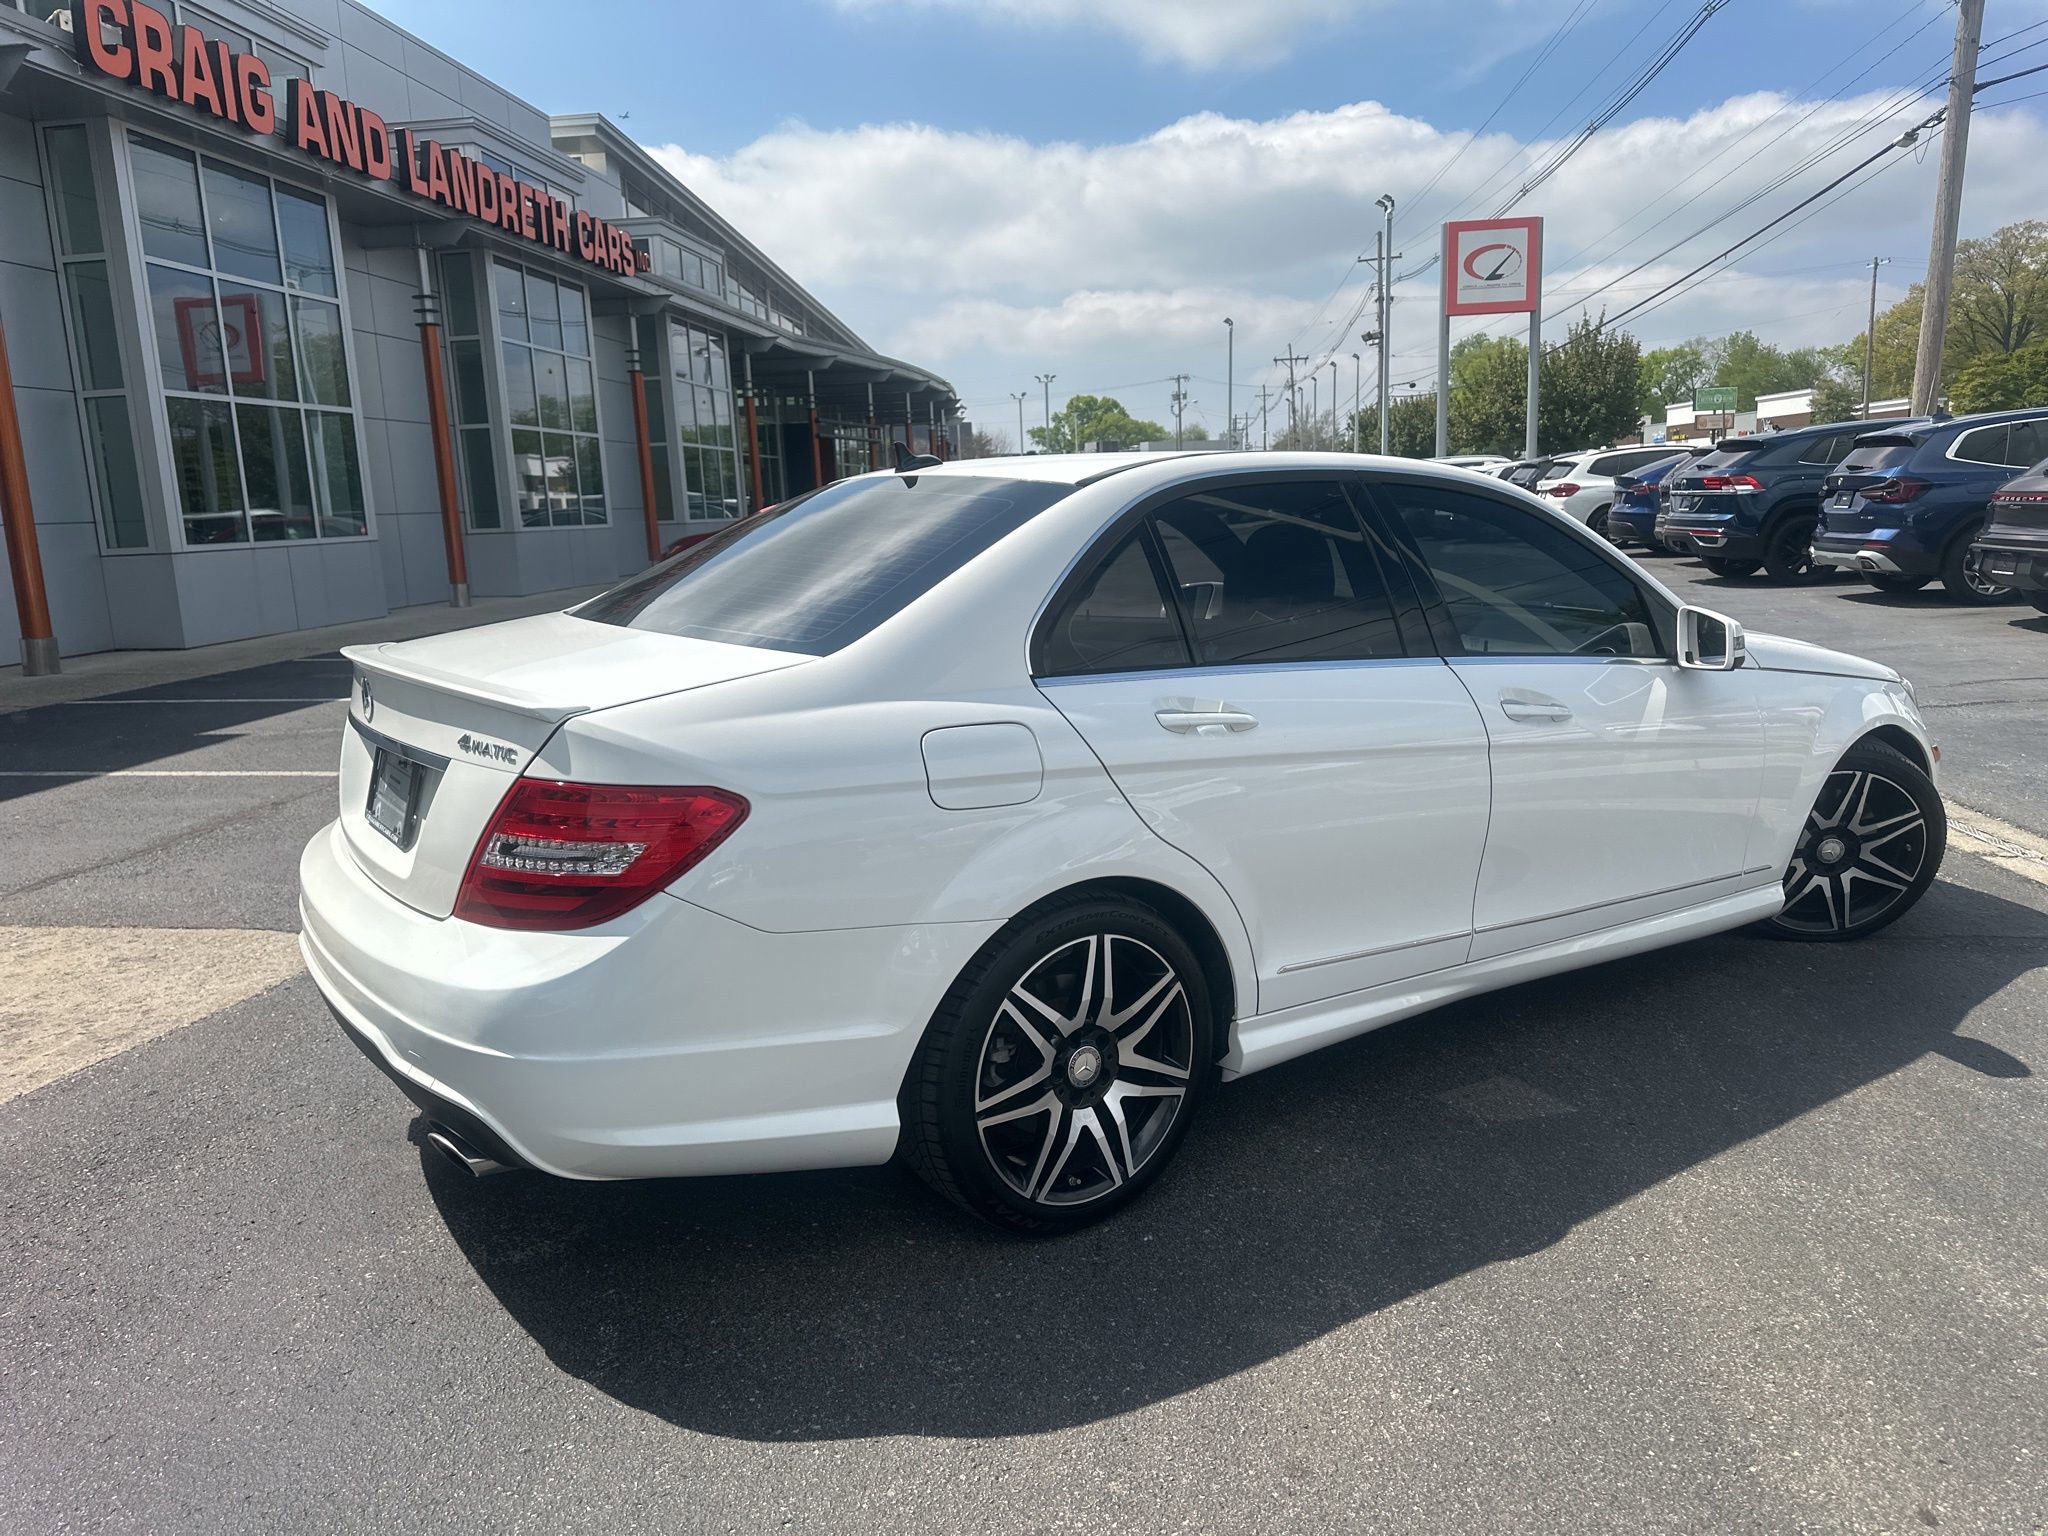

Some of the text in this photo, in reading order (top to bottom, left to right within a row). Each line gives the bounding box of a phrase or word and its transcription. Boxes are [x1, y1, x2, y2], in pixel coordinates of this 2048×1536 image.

[83, 0, 275, 135] CRAIG
[297, 78, 391, 181] AND
[404, 127, 570, 253] LANDRETH
[576, 209, 636, 278] CARS
